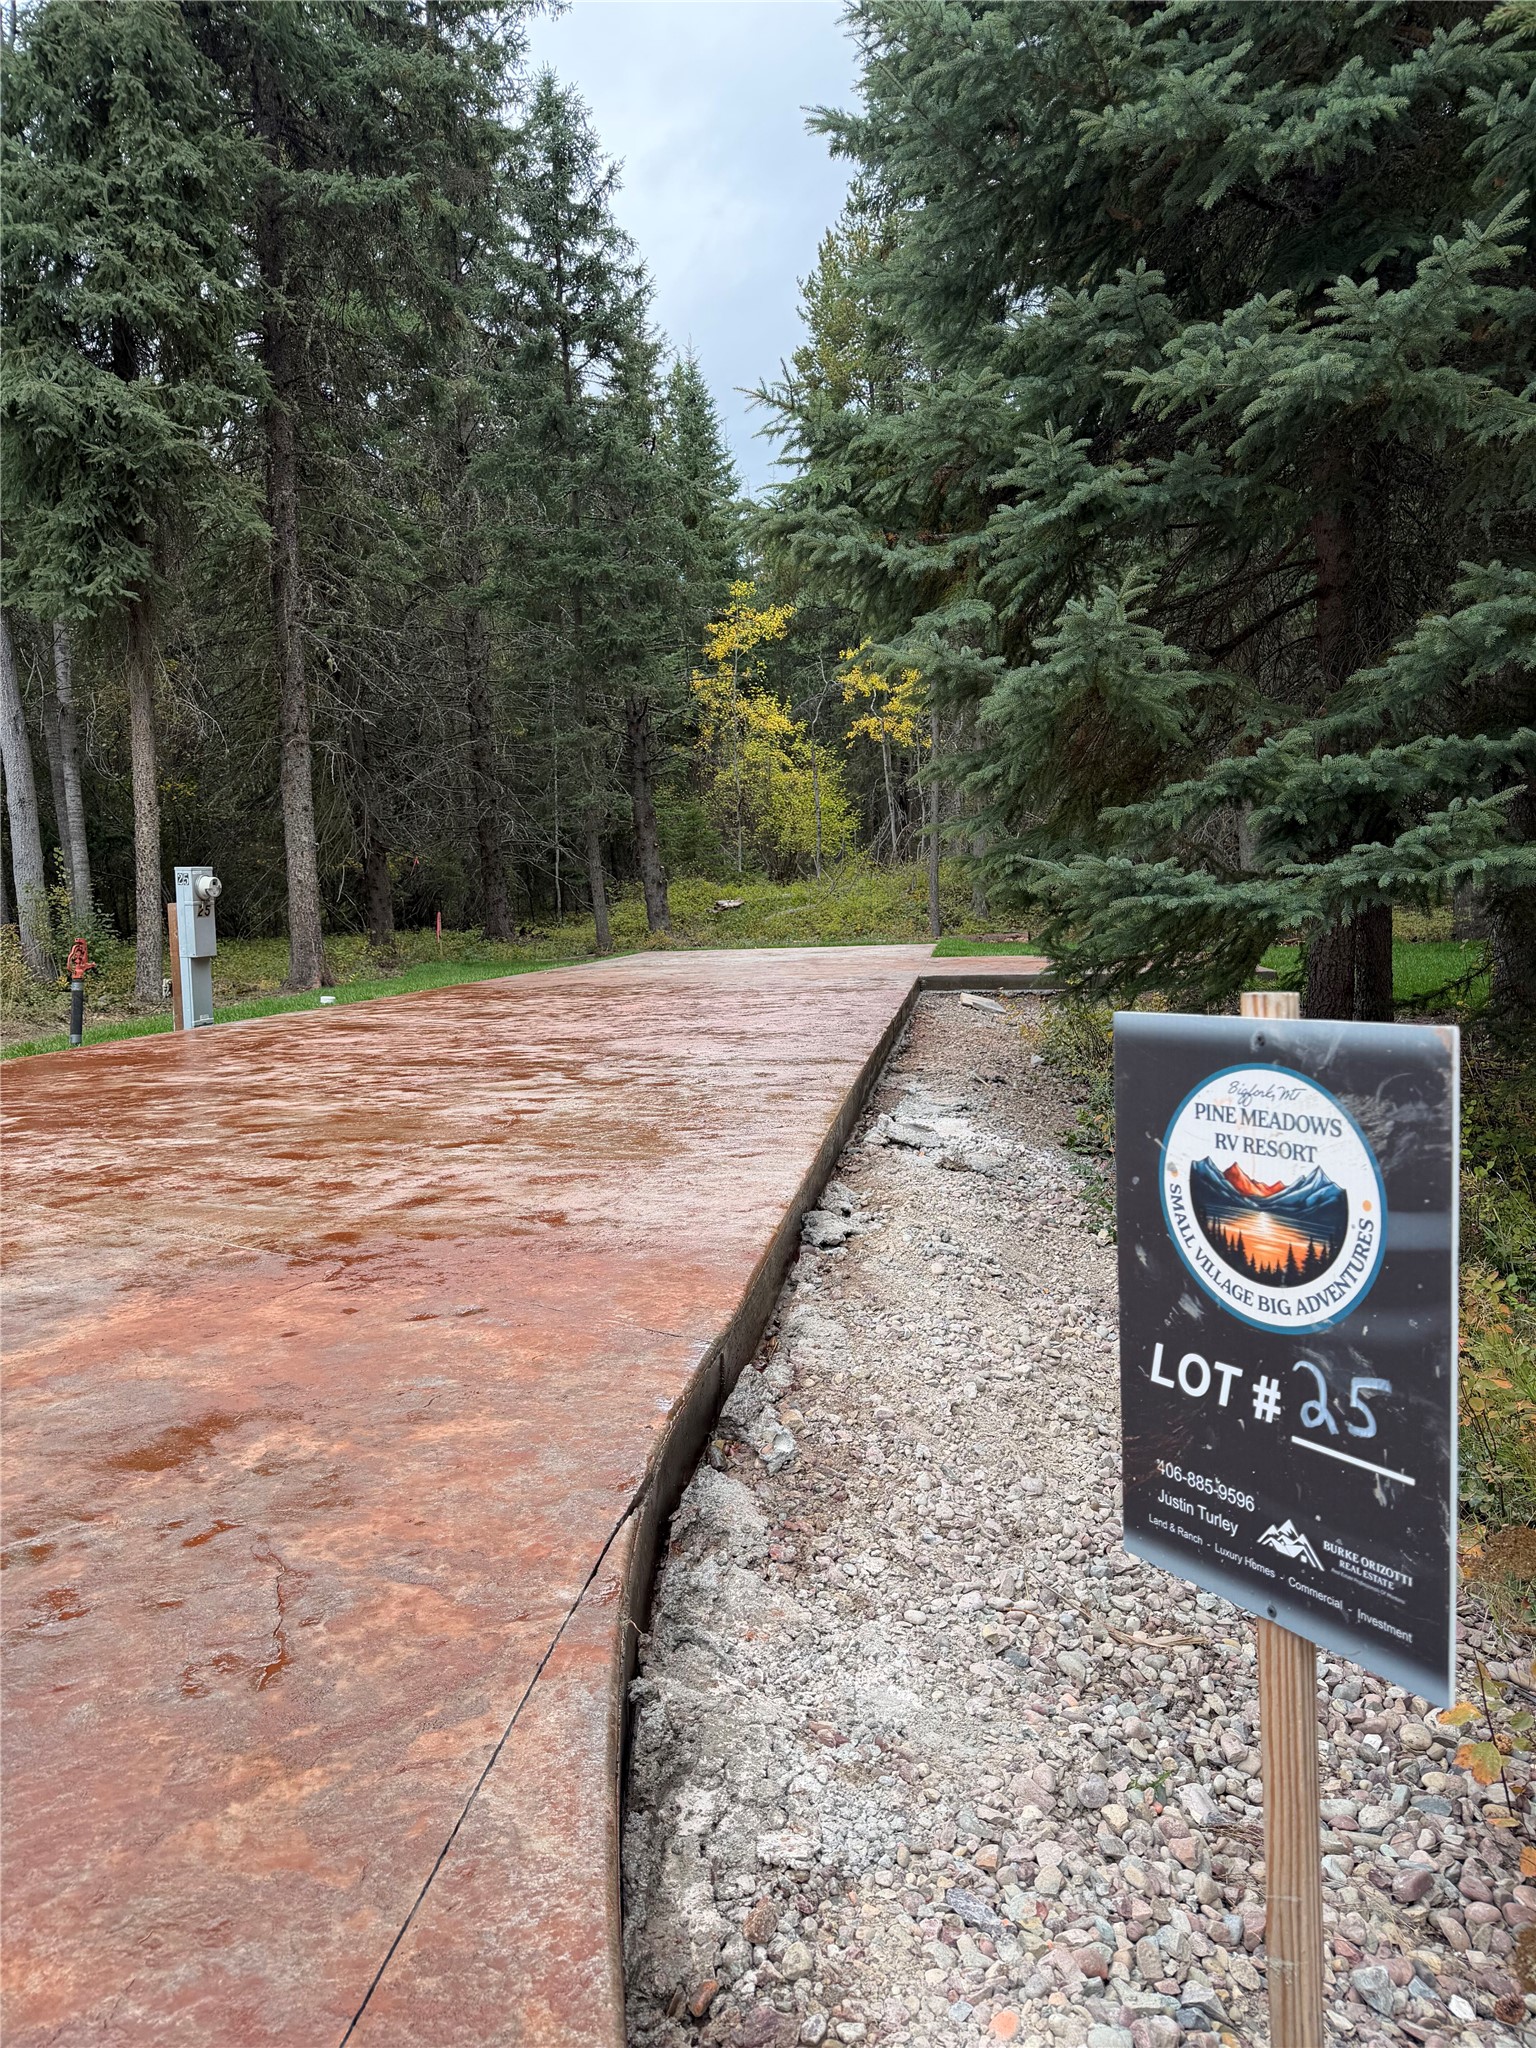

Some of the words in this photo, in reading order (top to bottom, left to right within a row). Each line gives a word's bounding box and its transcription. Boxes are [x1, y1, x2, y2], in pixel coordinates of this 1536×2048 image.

[177, 872, 190, 886] 25
[197, 904, 211, 917] 25
[1194, 1102, 1237, 1124] PINE
[1240, 1108, 1342, 1138] MEADOWS
[1214, 1132, 1239, 1151] RV
[1243, 1136, 1317, 1163] RESORT
[1170, 1183, 1193, 1248] SMALL
[1195, 1246, 1254, 1307] VILLAGE
[1258, 1295, 1292, 1316] BIG
[1297, 1218, 1374, 1316] ADVENTURES
[1150, 1342, 1243, 1407] LOT
[1252, 1375, 1281, 1423] #
[1292, 1360, 1393, 1438] 25
[1157, 1460, 1255, 1512] 406-885-9596
[1158, 1489, 1195, 1516] Justin
[1197, 1504, 1239, 1537] Turley
[1148, 1513, 1168, 1530] Land
[1169, 1522, 1176, 1533] &
[1177, 1526, 1203, 1546] Ranch
[1214, 1542, 1243, 1565] Luxury
[1244, 1556, 1276, 1578] Homes
[1288, 1576, 1343, 1610] Commercial
[1357, 1608, 1413, 1643] Investment
[1323, 1540, 1359, 1564] BURKE
[1360, 1557, 1413, 1587] ORIZOTTI
[1339, 1559, 1362, 1577] REAL
[1362, 1572, 1395, 1591] ESTATE
